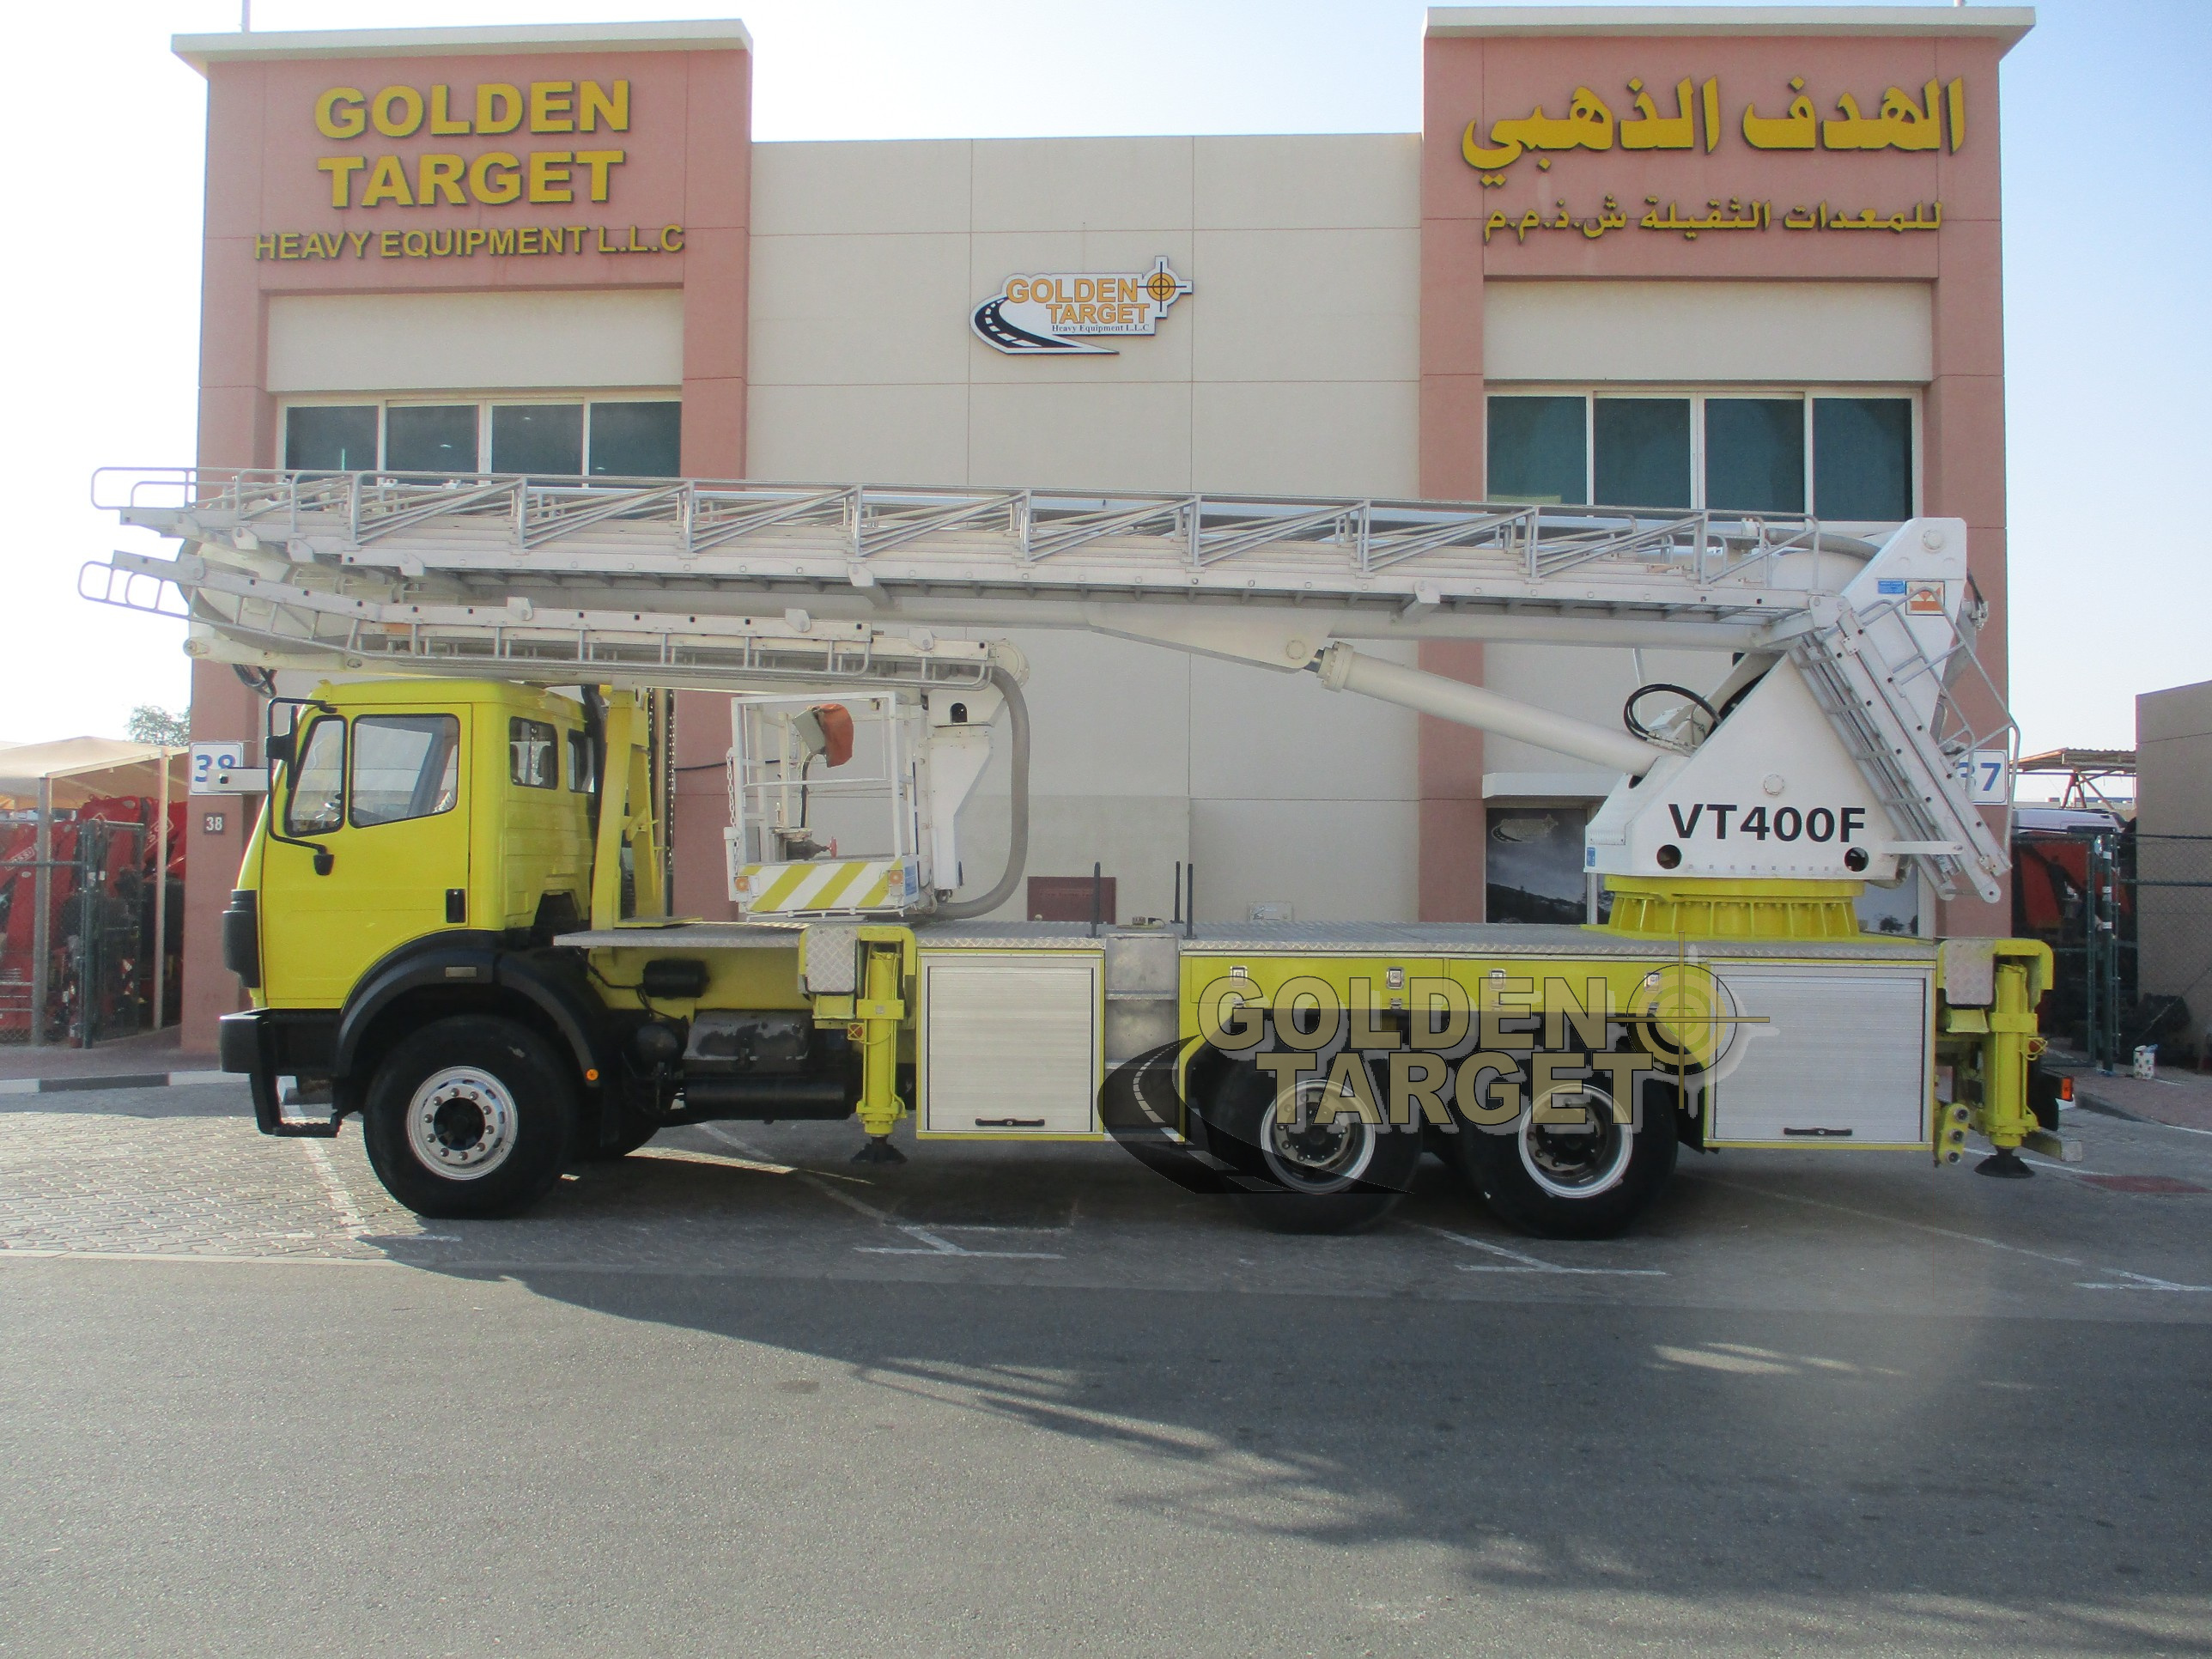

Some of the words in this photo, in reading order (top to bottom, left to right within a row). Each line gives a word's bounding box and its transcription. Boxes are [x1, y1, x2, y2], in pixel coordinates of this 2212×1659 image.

[314, 80, 631, 139] GOLDEN
[1742, 76, 1964, 155] الهدف
[1462, 75, 1718, 187] الذهبي
[318, 149, 625, 209] TARGET
[1640, 197, 1771, 240] الثقيلة
[1784, 200, 1943, 234] للمعدات
[255, 229, 371, 259] HEAVY
[380, 226, 588, 258] EQUIPMENT
[599, 224, 684, 253] L.L.C
[1006, 278, 1139, 303] GOLDEN
[1046, 303, 1150, 324] TARGET
[1052, 324, 1077, 333] Heavy
[1079, 324, 1124, 333] Equipment
[205, 816, 223, 831] 38
[1668, 803, 1866, 843] VT400F
